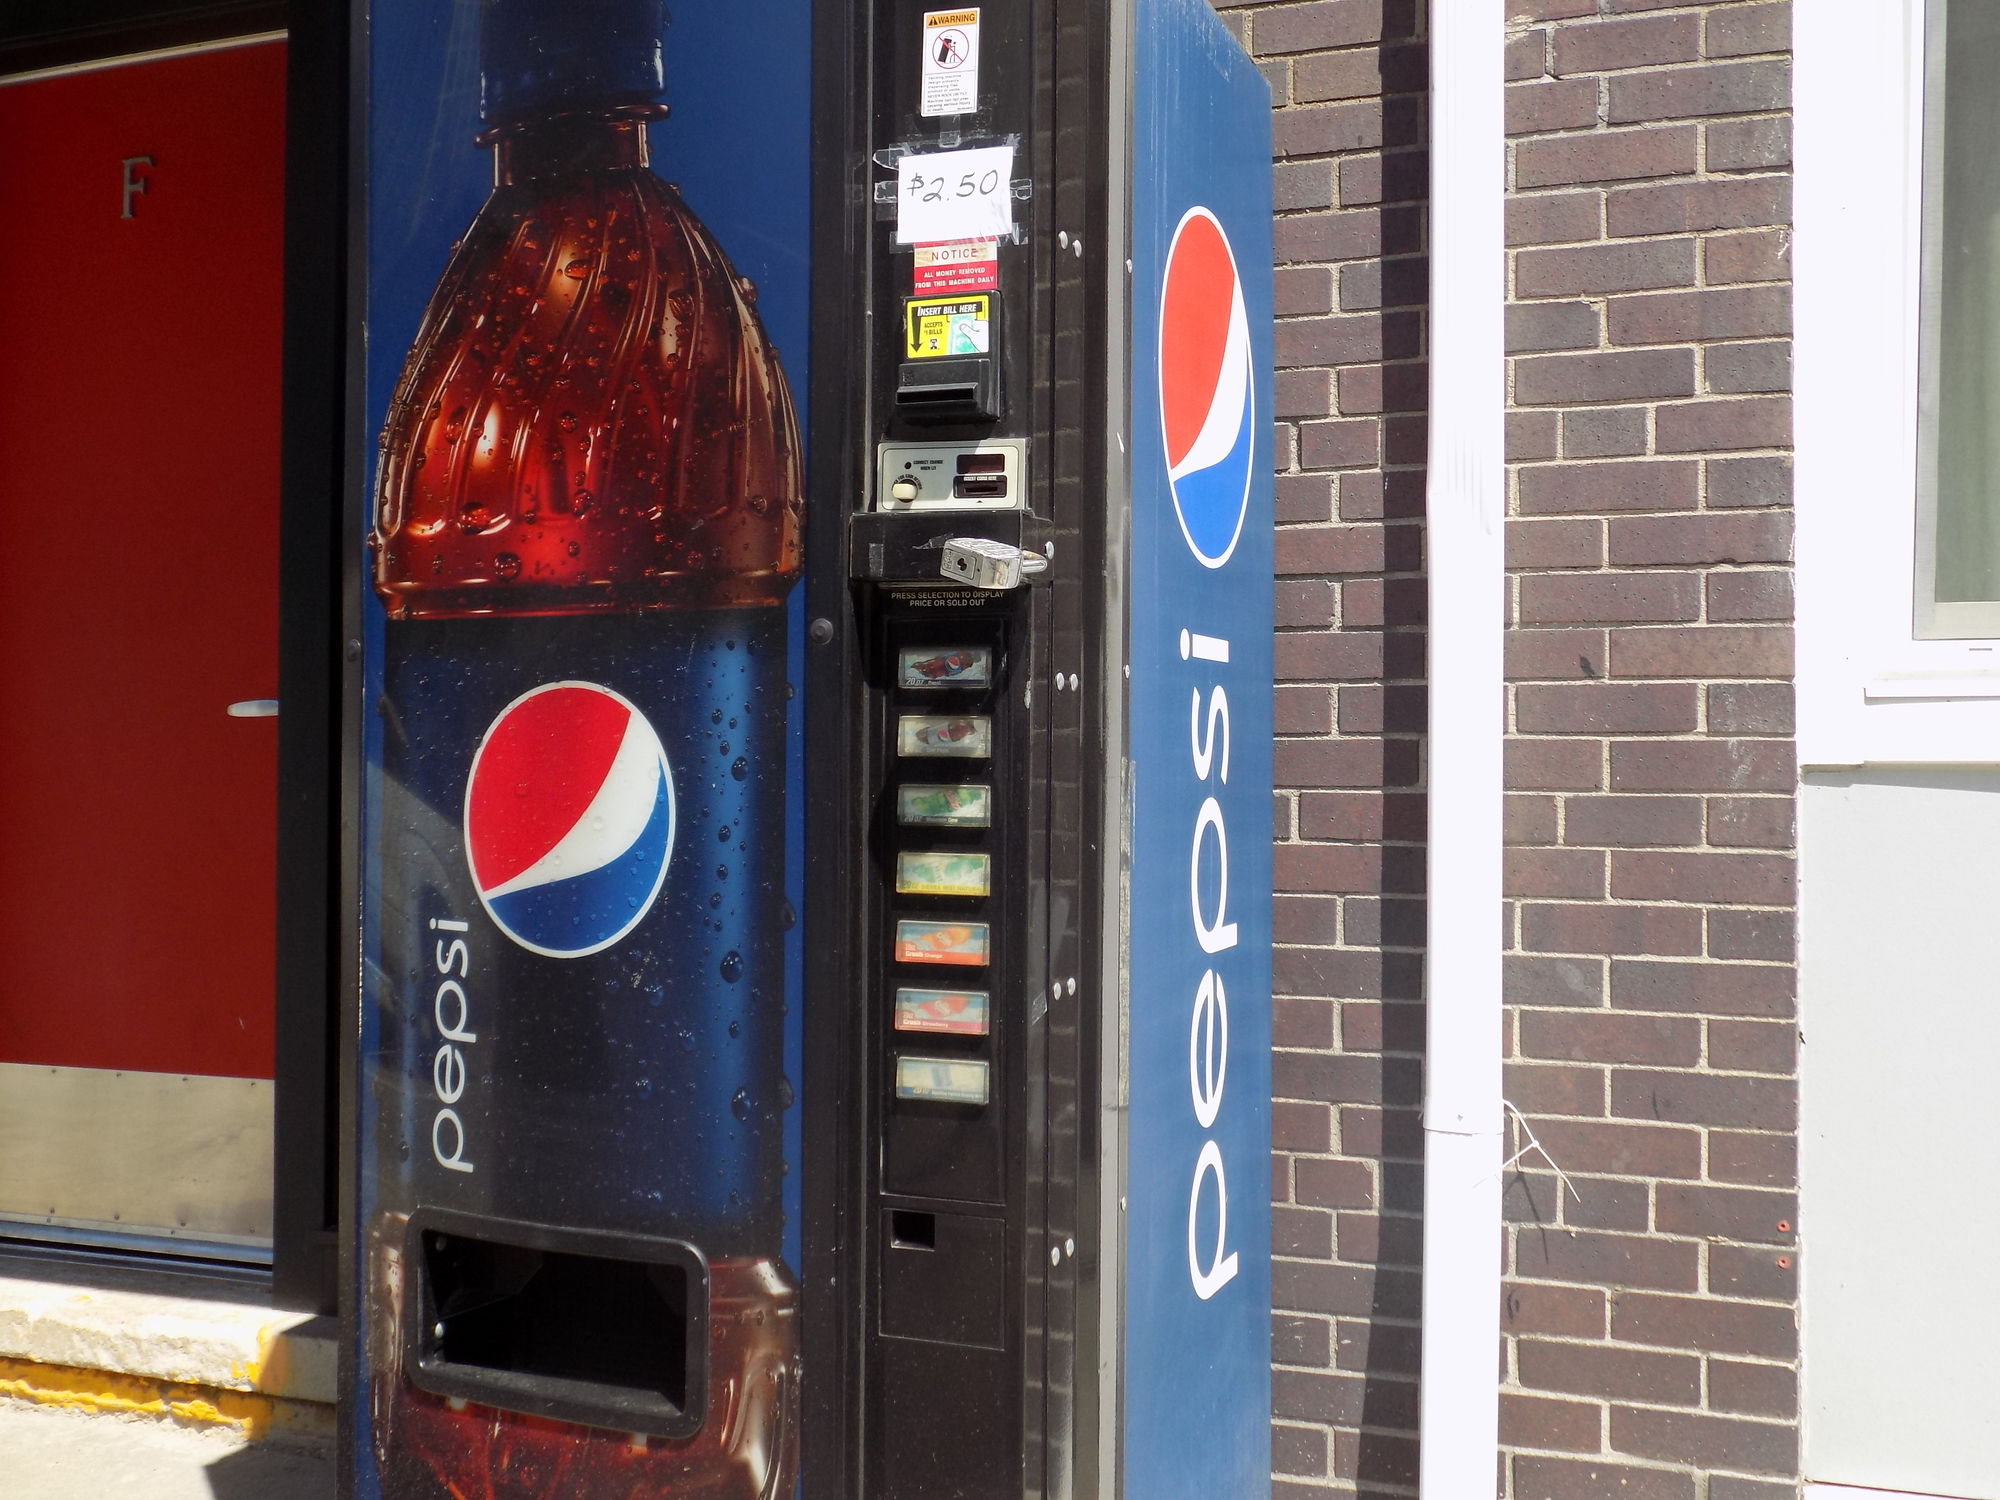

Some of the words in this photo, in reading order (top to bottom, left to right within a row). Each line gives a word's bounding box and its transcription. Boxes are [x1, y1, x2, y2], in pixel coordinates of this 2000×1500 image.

[937, 13, 975, 24] WARNING
[120, 155, 155, 219] F
[907, 169, 998, 202] $2.50
[931, 248, 978, 261] NOTICE
[935, 269, 957, 277] MONEY
[958, 267, 986, 275] REMOVED
[915, 281, 931, 289] FROM
[948, 278, 975, 286] MACHINE
[977, 276, 994, 284] DAILY
[917, 306, 941, 317] INSERT
[943, 305, 957, 314] BILL
[959, 304, 978, 313] HERE
[924, 321, 943, 329] ACCEPTS
[891, 592, 917, 600] PRESS
[917, 591, 960, 599] SELECTION
[961, 591, 971, 599] TO
[909, 599, 932, 607] PRICE
[1180, 628, 1238, 1300] pepsi
[430, 917, 476, 1173] pepsi
